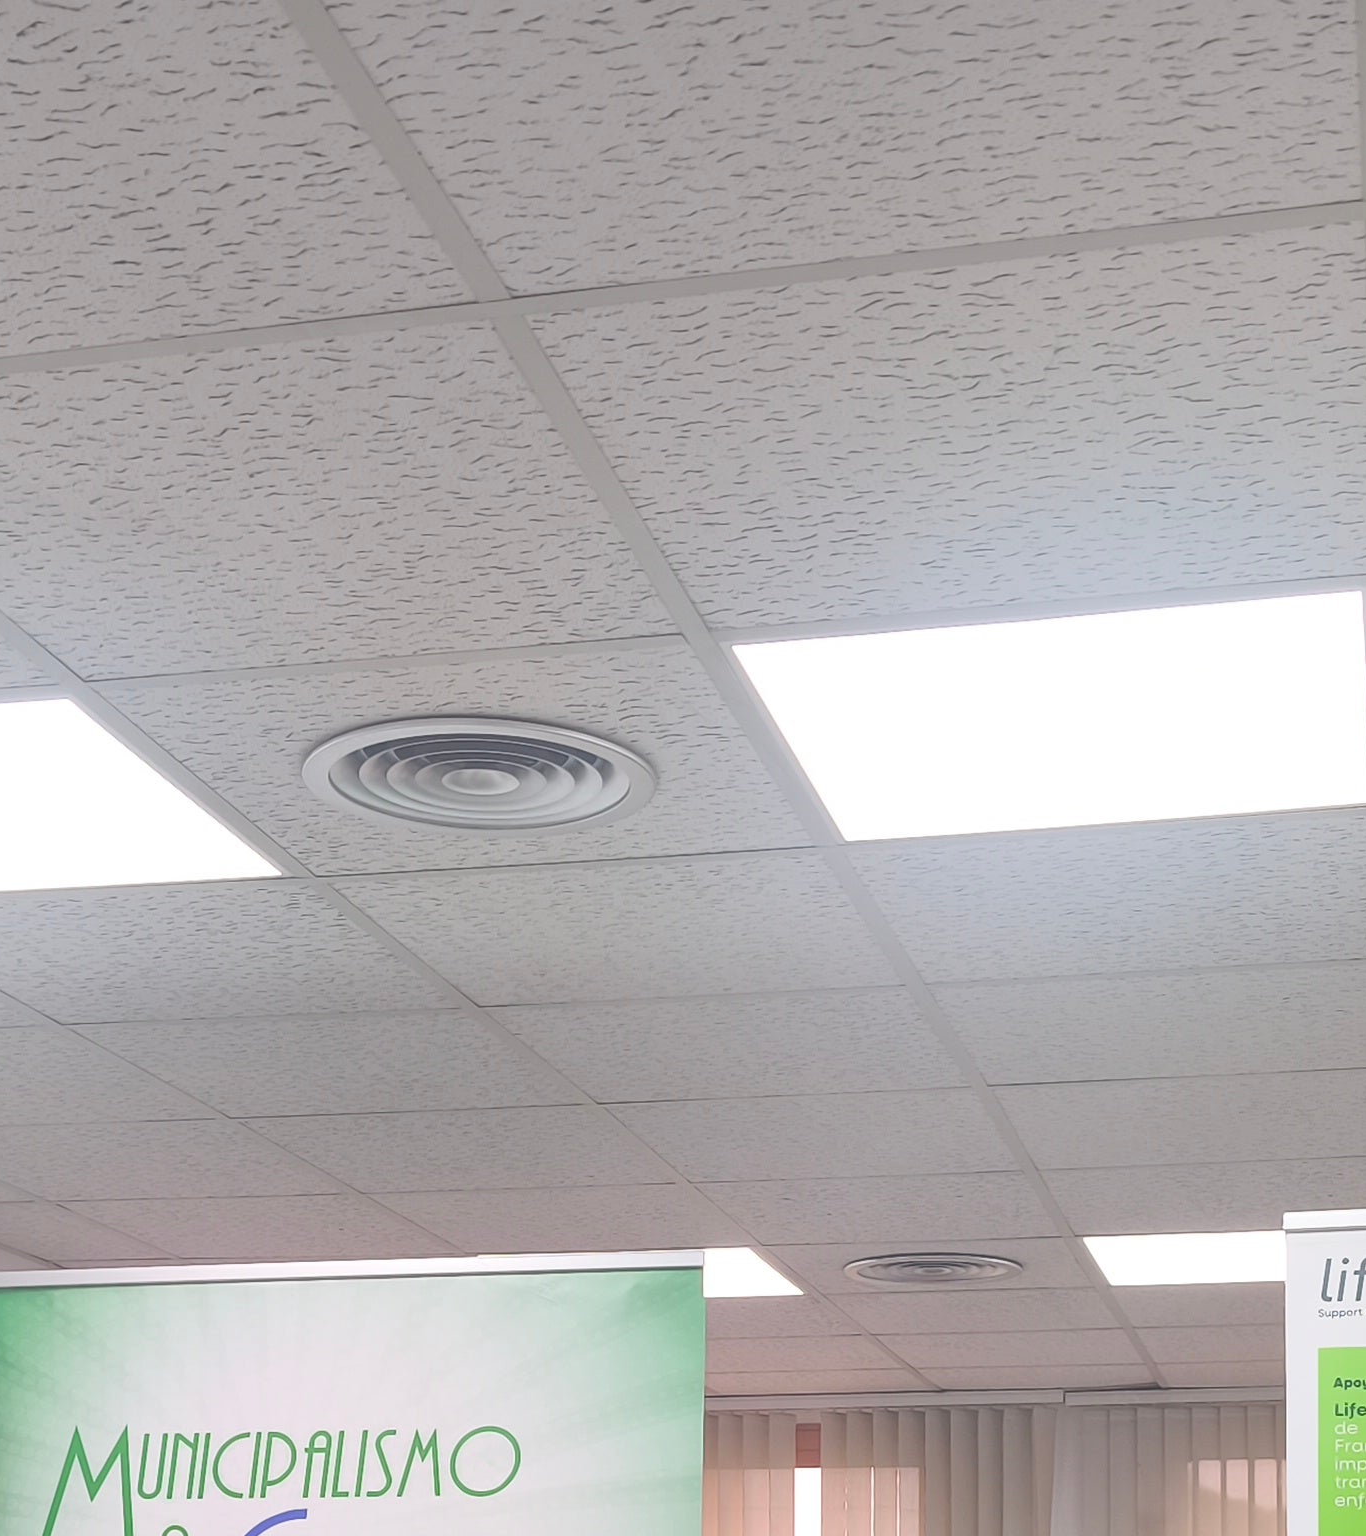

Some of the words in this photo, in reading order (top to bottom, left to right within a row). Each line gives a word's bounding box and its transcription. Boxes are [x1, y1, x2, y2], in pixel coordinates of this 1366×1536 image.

[1318, 1309, 1362, 1318] Support
[1335, 1403, 1366, 1419] Life
[1335, 1422, 1358, 1434] de
